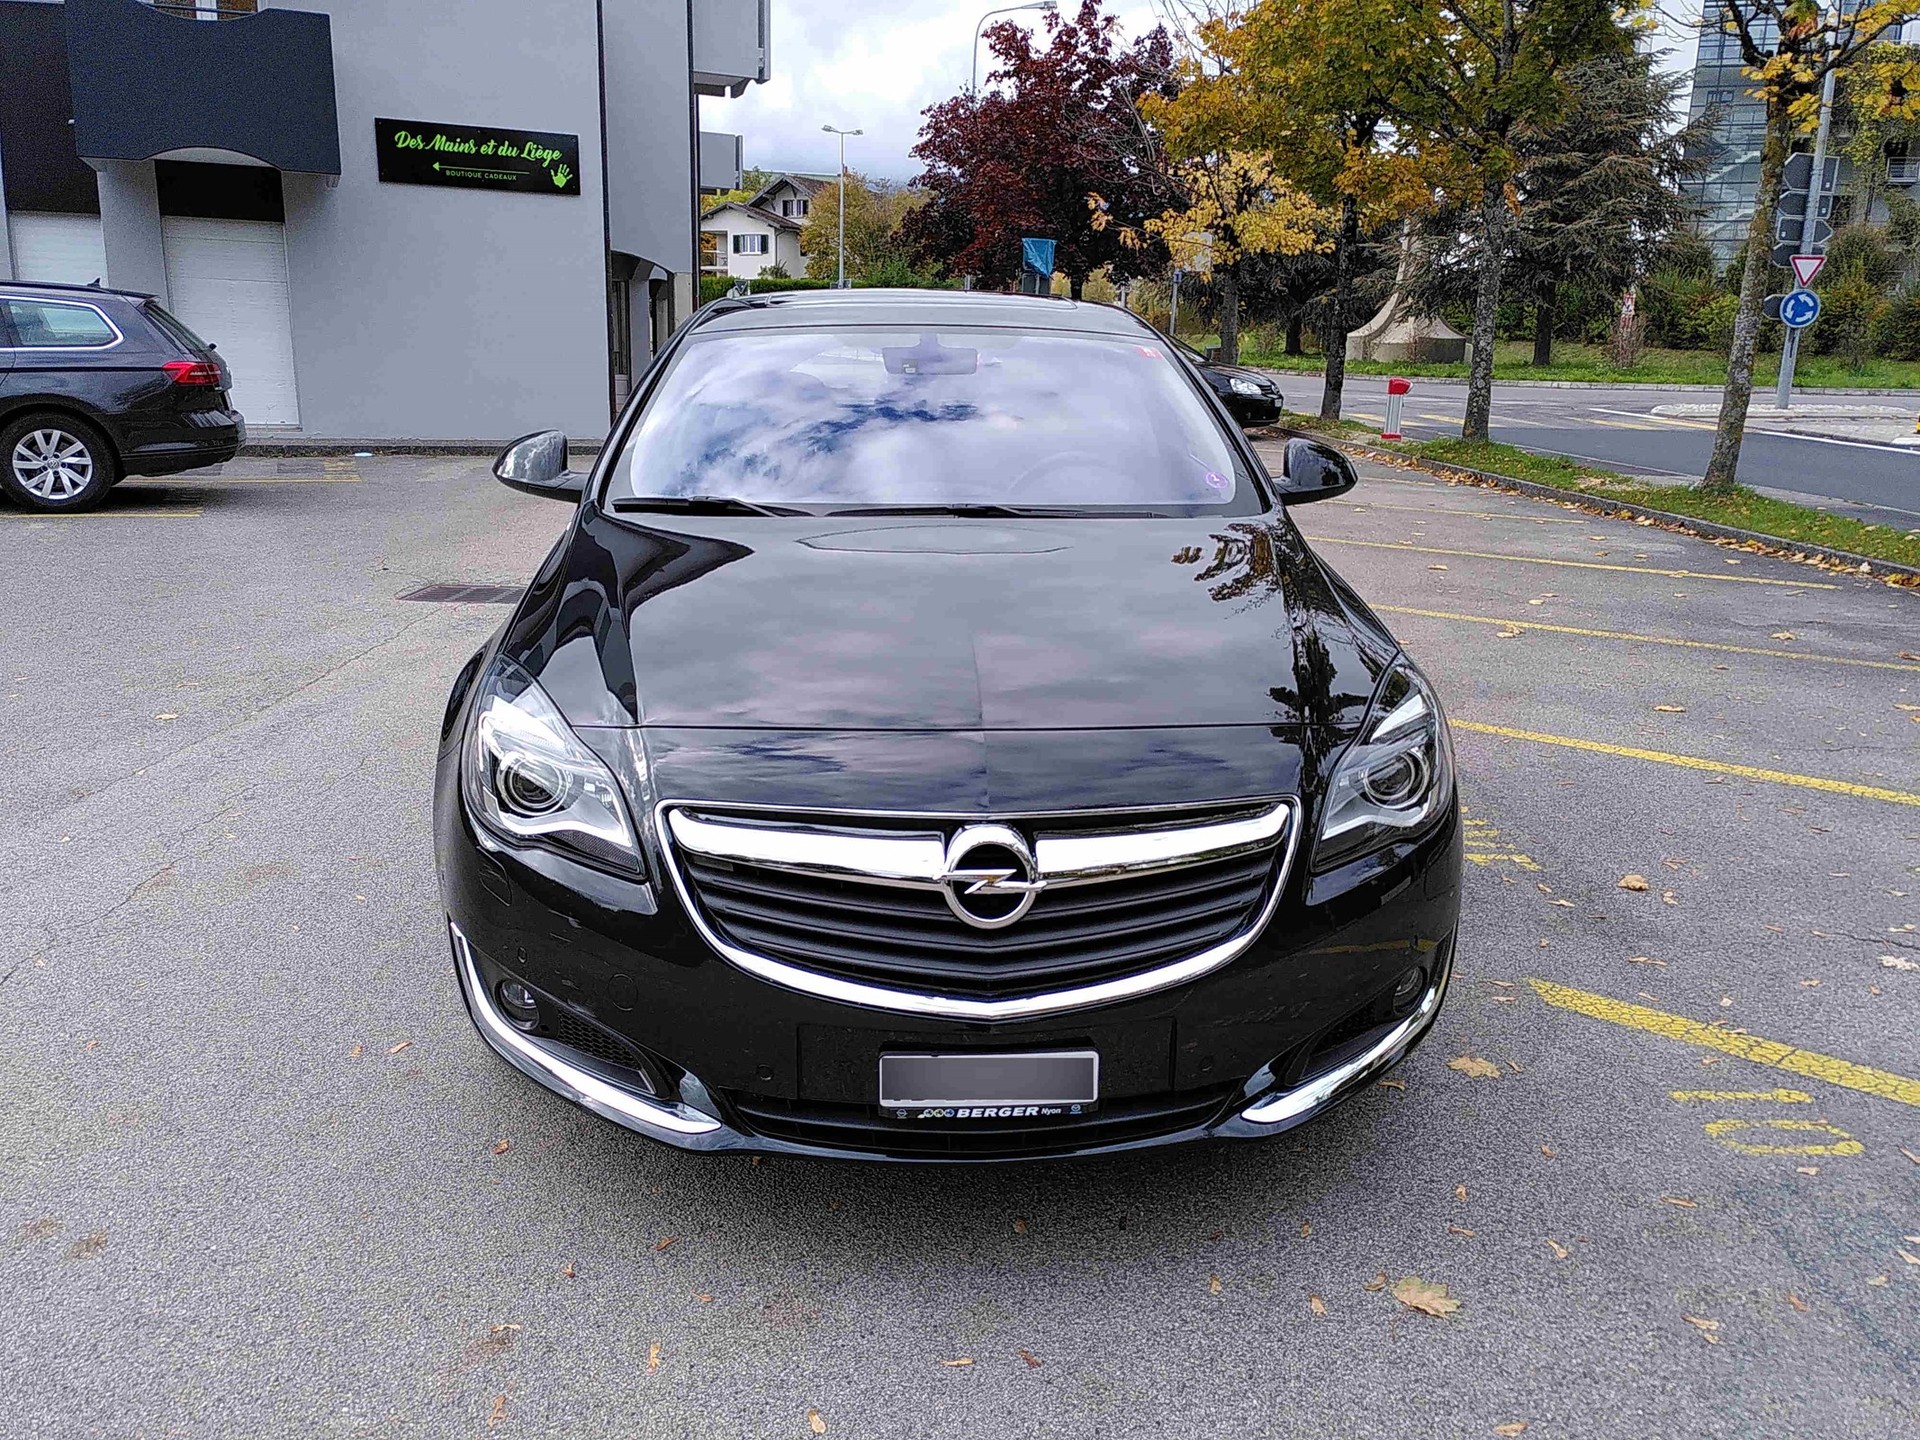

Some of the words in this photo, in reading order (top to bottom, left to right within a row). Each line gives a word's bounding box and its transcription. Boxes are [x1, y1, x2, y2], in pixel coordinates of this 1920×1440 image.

[394, 130, 425, 150] Des
[425, 133, 478, 154] Mains
[480, 139, 497, 155] et
[498, 141, 519, 158] du
[520, 141, 562, 168] Liège
[445, 169, 482, 179] BOUTIQUE
[484, 172, 517, 181] CADEAUX
[956, 1106, 1040, 1118] BERGER
[1041, 1107, 1062, 1116] Nyon
